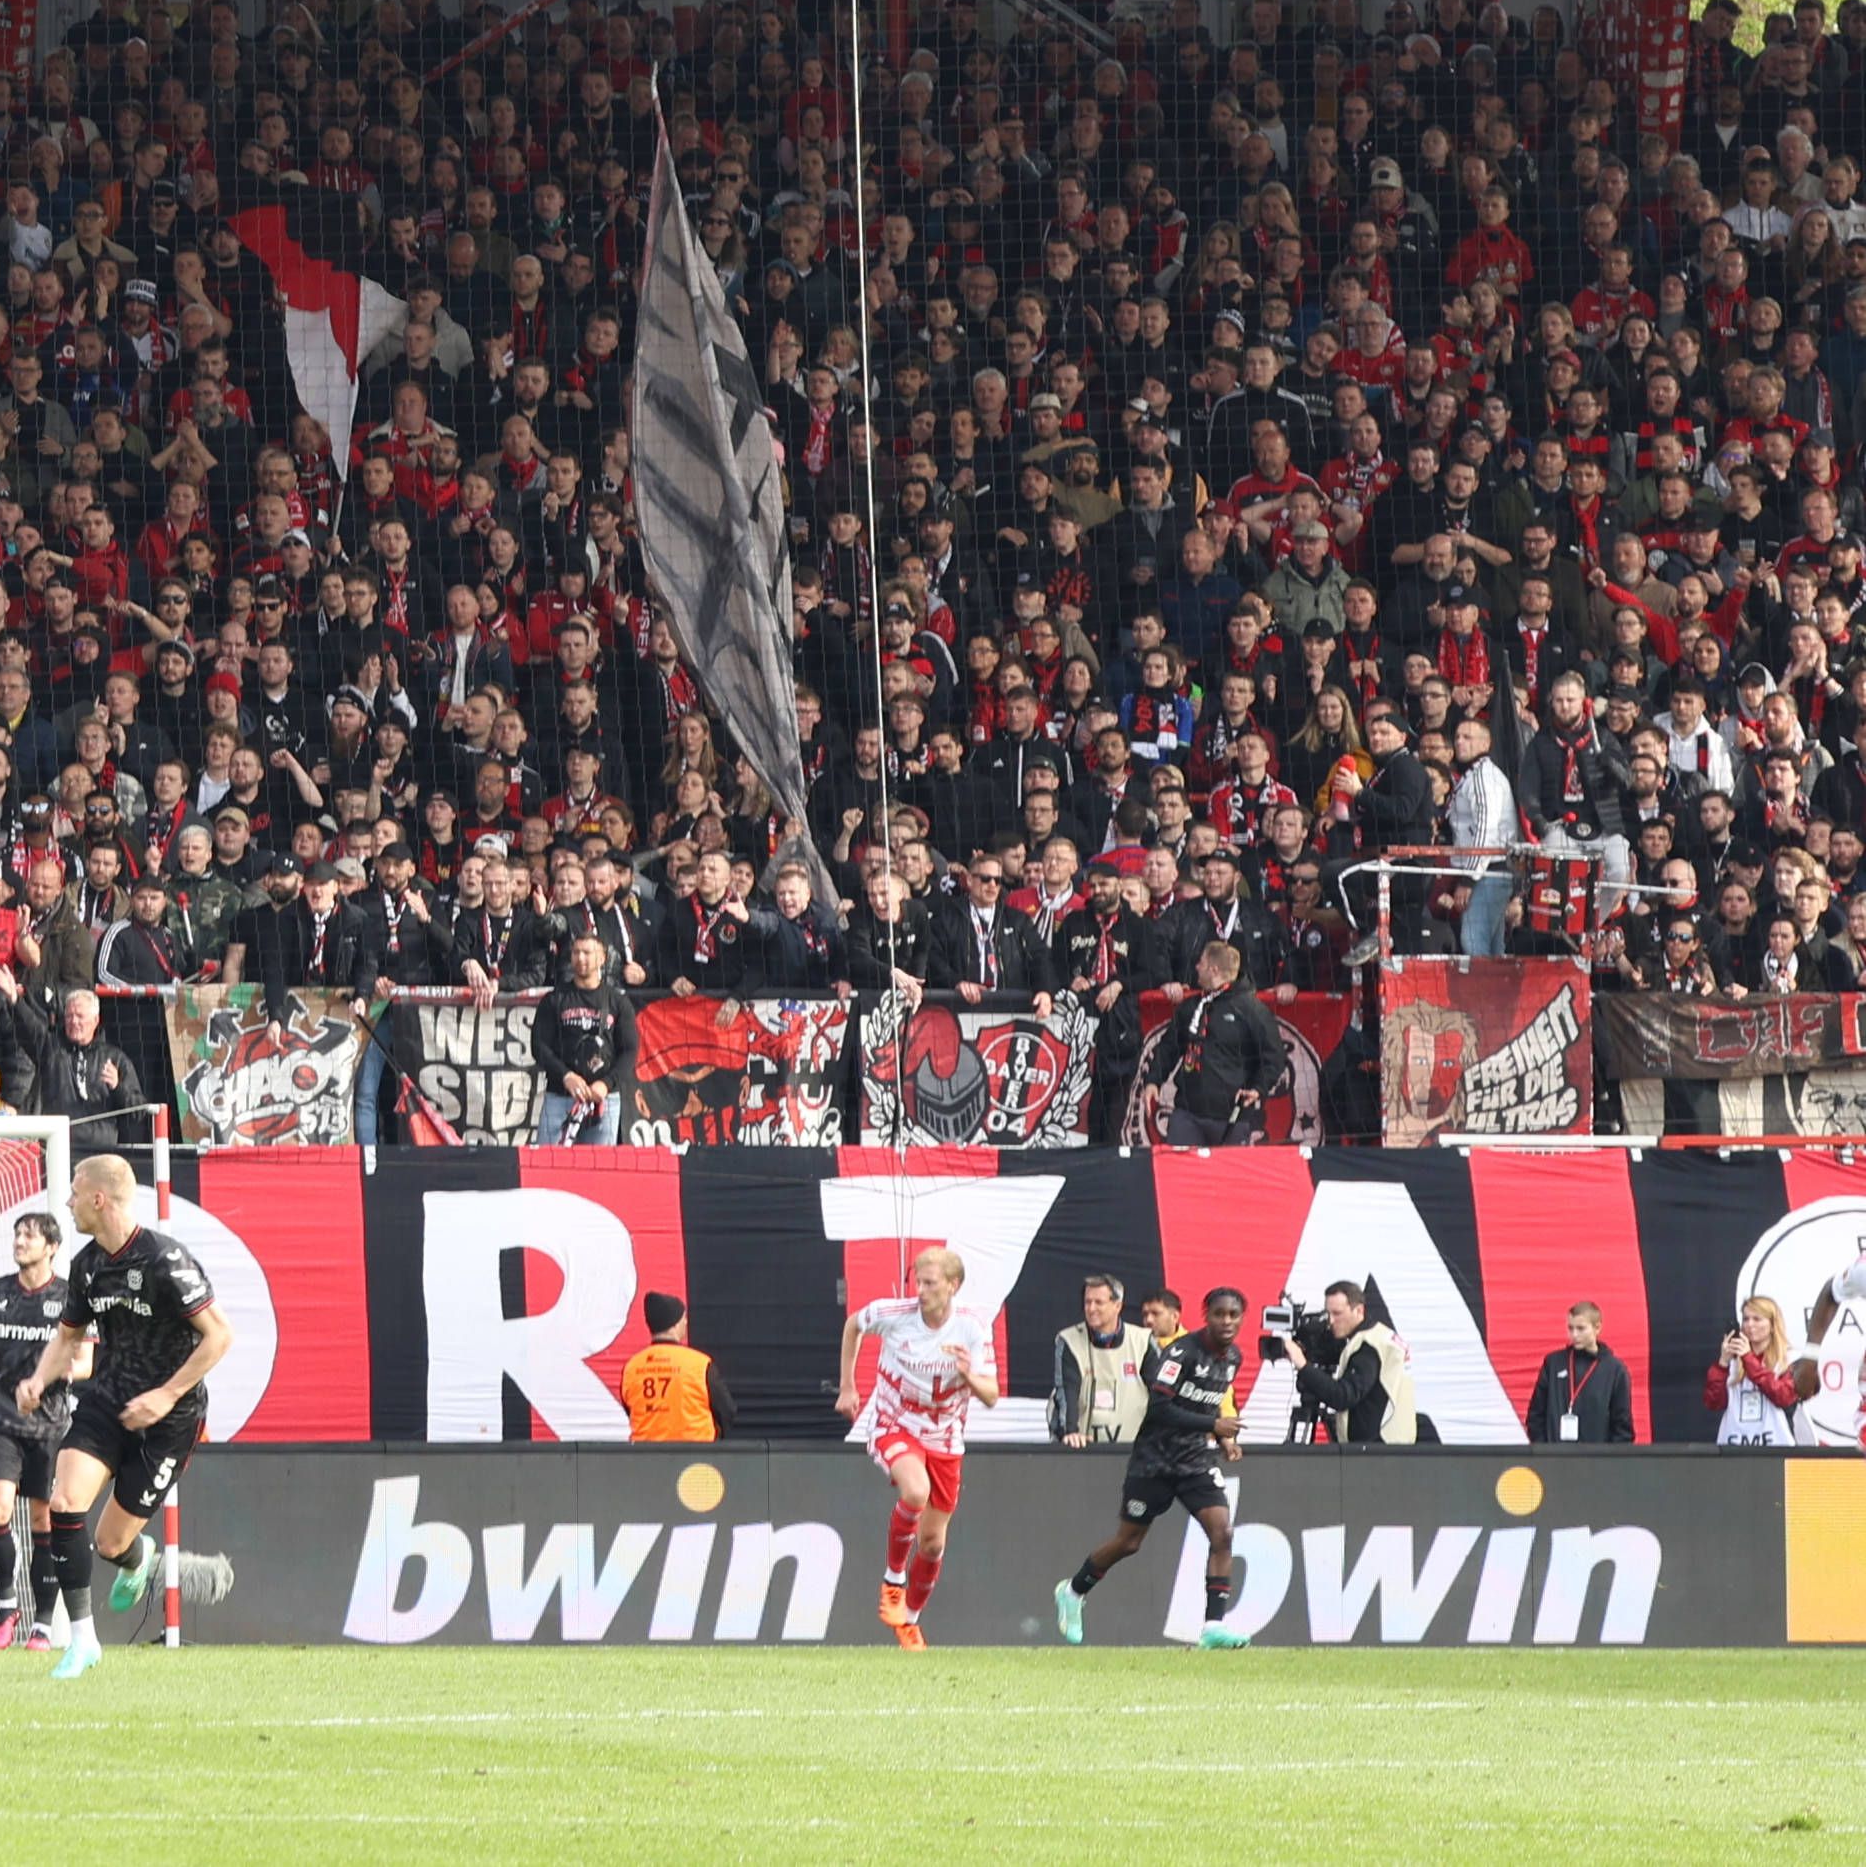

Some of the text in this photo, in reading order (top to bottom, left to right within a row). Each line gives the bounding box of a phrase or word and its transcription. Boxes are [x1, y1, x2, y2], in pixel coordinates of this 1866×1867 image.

[418, 1005, 539, 1067] WES
[1013, 1037, 1031, 1110] BAYER
[1466, 1051, 1565, 1114] FÜR DIE
[986, 1110, 1026, 1135] 04
[1465, 1086, 1580, 1134] ULTRAS
[642, 1377, 672, 1399] 87
[1090, 1423, 1123, 1443] TV
[153, 1456, 178, 1491] 5
[342, 1461, 844, 1644] bwin
[1163, 1465, 1662, 1645] bwin
